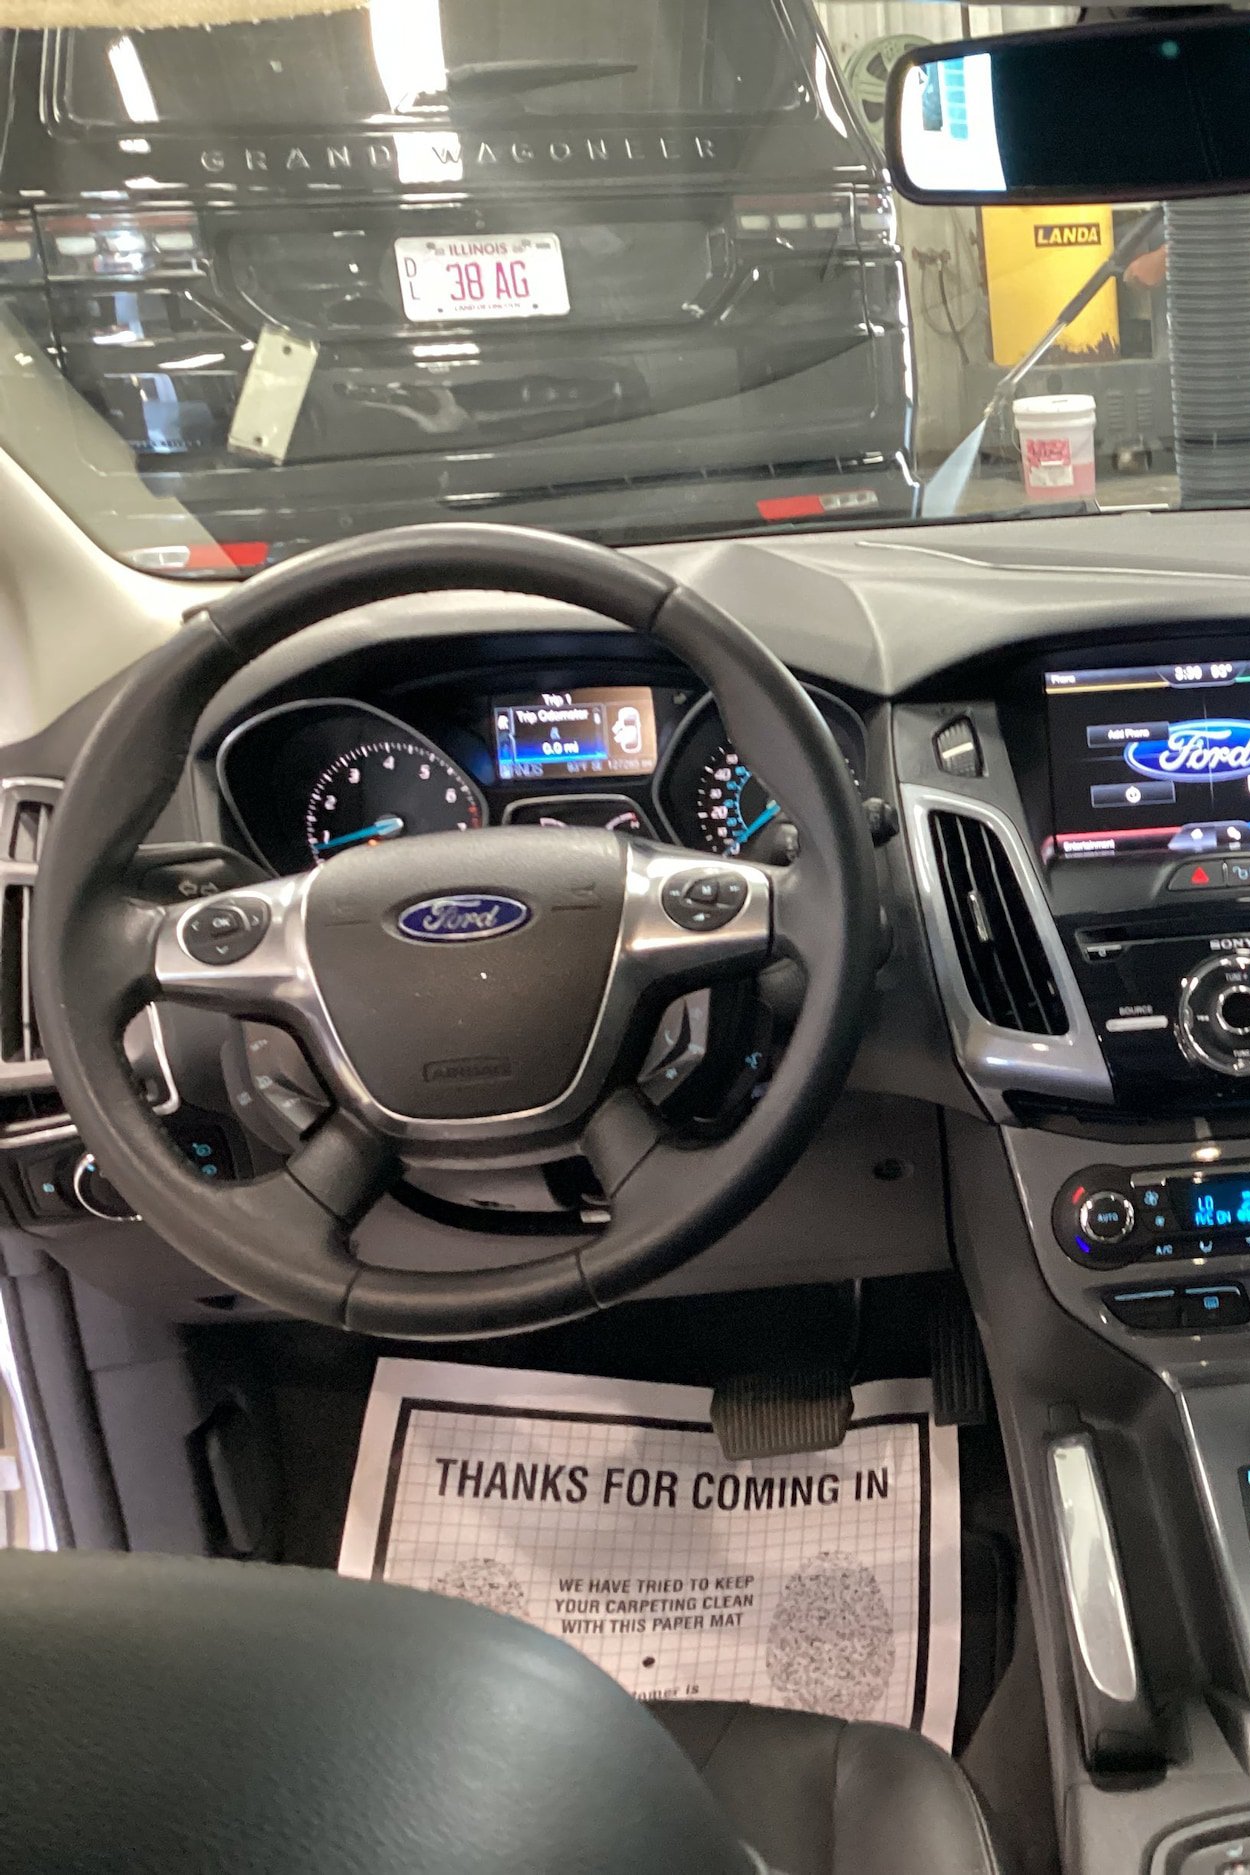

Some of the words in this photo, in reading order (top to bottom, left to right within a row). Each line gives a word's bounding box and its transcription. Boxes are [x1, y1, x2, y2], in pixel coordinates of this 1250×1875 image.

[201, 145, 392, 172] GRAND
[1037, 226, 1098, 244] LANDA
[449, 242, 508, 257] ILLINOIS
[404, 257, 417, 278] D
[446, 261, 485, 301] 38
[495, 260, 530, 299] AG
[409, 281, 420, 300] L
[542, 693, 564, 708] Trip
[516, 710, 538, 724] Trip
[538, 709, 588, 722] Odometer
[542, 741, 563, 755] 0.0
[383, 755, 395, 770] 4
[348, 768, 360, 783] 3
[418, 764, 431, 779] 5
[324, 795, 337, 810] 2
[445, 788, 457, 803] 6
[1063, 839, 1115, 852] Entertainment
[423, 900, 500, 931] Ford
[1119, 1005, 1153, 1016] SOURCE
[1097, 1212, 1119, 1223] AUTO
[1156, 1244, 1173, 1255] A/C
[436, 1458, 589, 1504] THANKS
[603, 1468, 678, 1508] FOR
[692, 1472, 840, 1511] COMING
[855, 1467, 888, 1501] IN
[559, 1578, 584, 1593] WE
[589, 1578, 631, 1594] HAVE
[637, 1578, 683, 1594] TRIED
[690, 1577, 709, 1591] TO
[715, 1575, 755, 1590] KEEP
[555, 1599, 600, 1614] YOUR
[606, 1597, 697, 1614] CARPETING
[702, 1594, 754, 1610] CLEAN
[562, 1618, 604, 1634] WITH
[609, 1618, 646, 1633] THIS
[652, 1615, 704, 1632] PAPER
[710, 1612, 743, 1627] MAT
[686, 1684, 699, 1696] is
